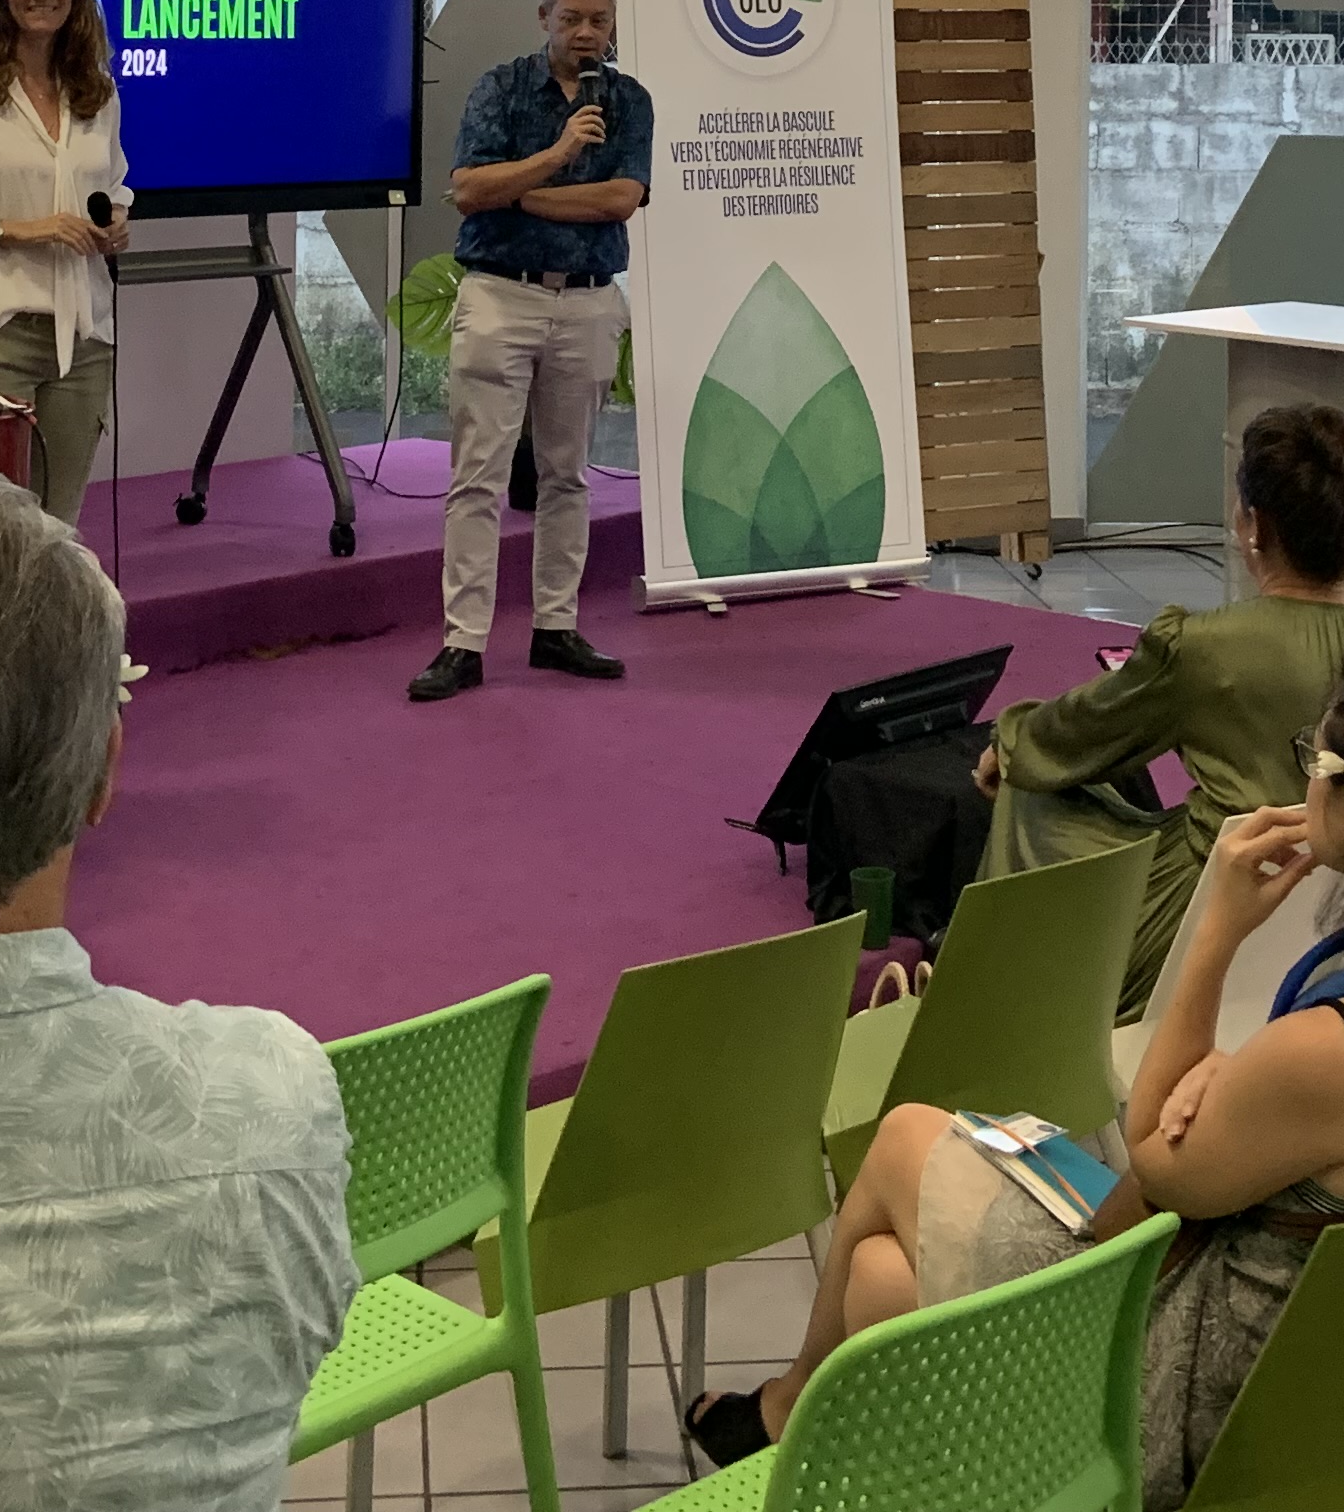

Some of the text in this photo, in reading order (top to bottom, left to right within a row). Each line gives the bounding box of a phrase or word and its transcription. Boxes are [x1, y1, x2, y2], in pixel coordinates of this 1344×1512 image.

[121, 48, 168, 77] 2024
[698, 107, 836, 134] ACCÉLÉRER LA BASCULE
[670, 132, 865, 163] VERS L'ÉCONOMIE RÉGÉNÉRATIVE
[682, 160, 856, 191] ET DÉVELOPPER LA RÉSILIENCE
[723, 192, 820, 218] DES TERRITOIRES
